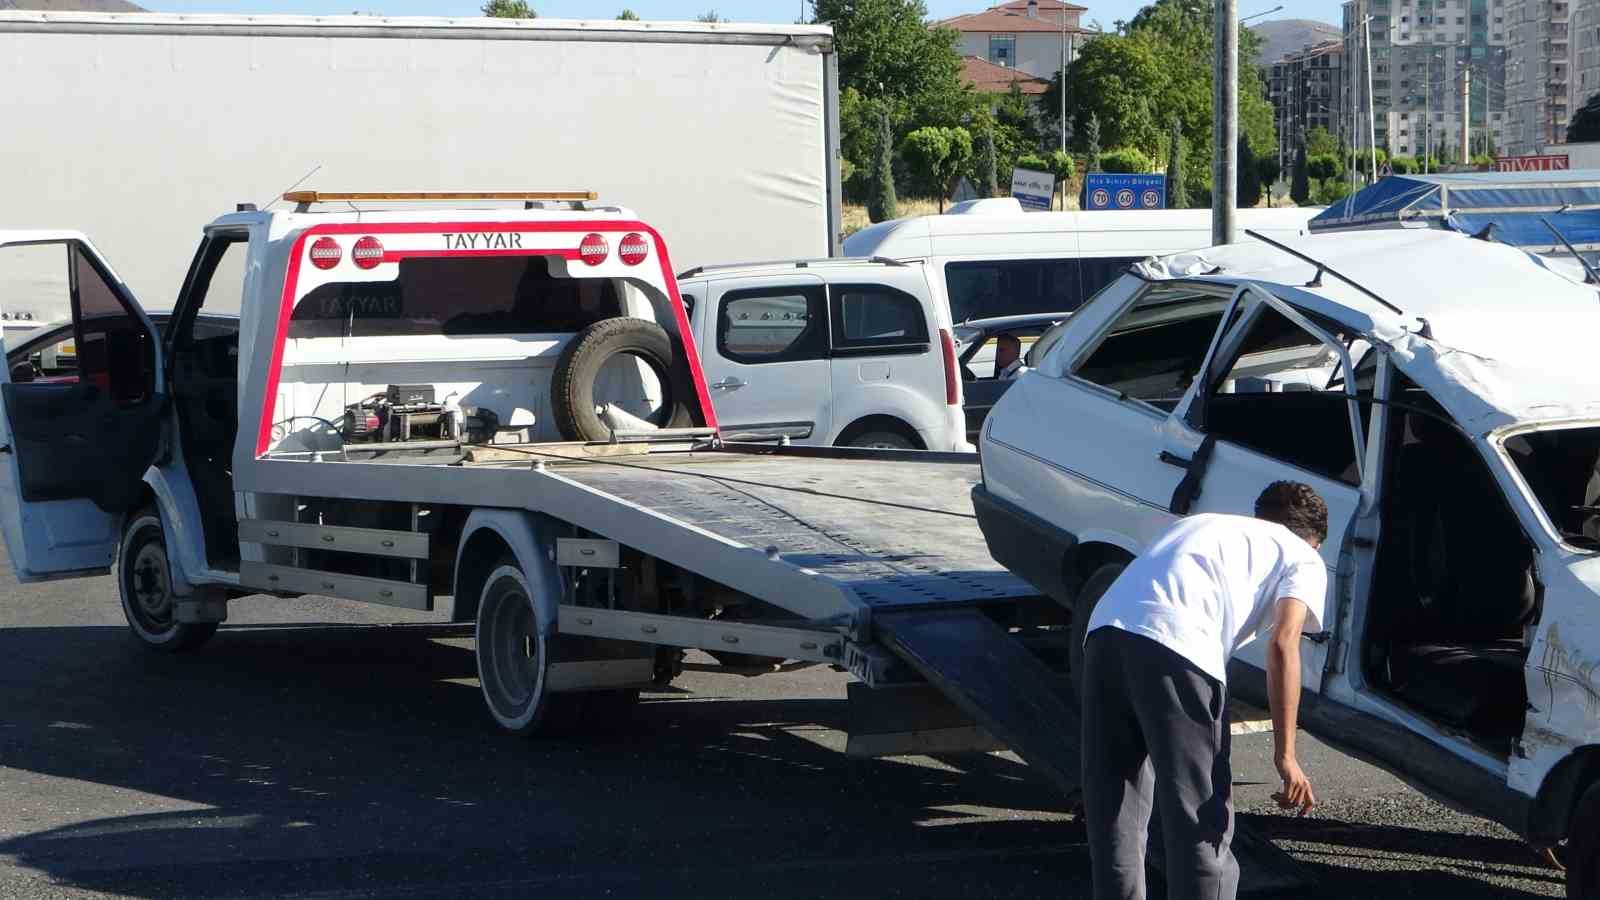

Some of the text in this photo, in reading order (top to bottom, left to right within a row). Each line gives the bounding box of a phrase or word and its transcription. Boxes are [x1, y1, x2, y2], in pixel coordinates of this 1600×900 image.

[1095, 195, 1107, 203] 70
[1120, 194, 1131, 203] 60
[1145, 195, 1157, 204] 50
[442, 232, 522, 249] TAYYAR
[319, 296, 398, 313] TAYYAR
